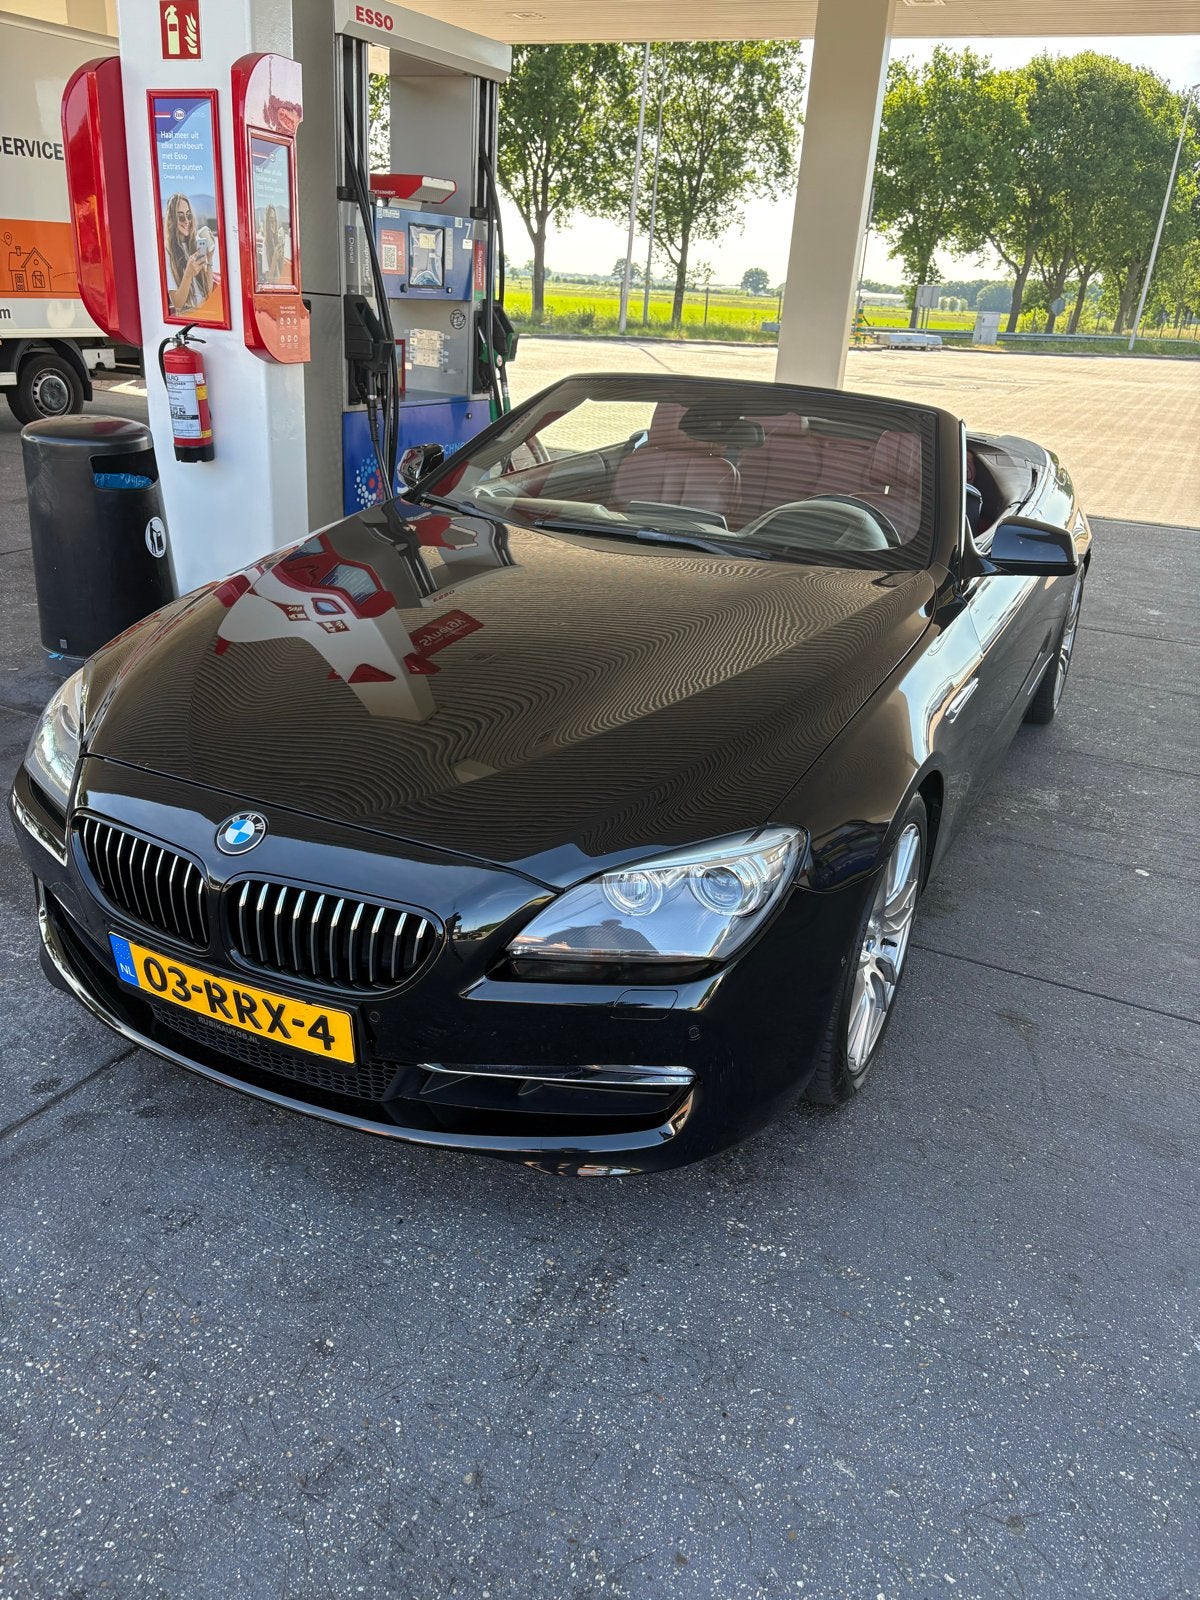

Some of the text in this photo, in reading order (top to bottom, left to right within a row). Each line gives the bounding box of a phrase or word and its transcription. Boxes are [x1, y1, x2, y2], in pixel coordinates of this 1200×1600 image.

[355, 5, 394, 31] ESSO
[160, 130, 199, 140] Haal meer uit
[0, 136, 64, 161] ERVICE
[174, 142, 203, 150] tankbeurt
[162, 152, 188, 160] met Esso
[162, 162, 181, 171] Extras
[464, 222, 472, 239] 7
[119, 962, 135, 978] NL
[143, 956, 336, 1051] 03-RRX-4
